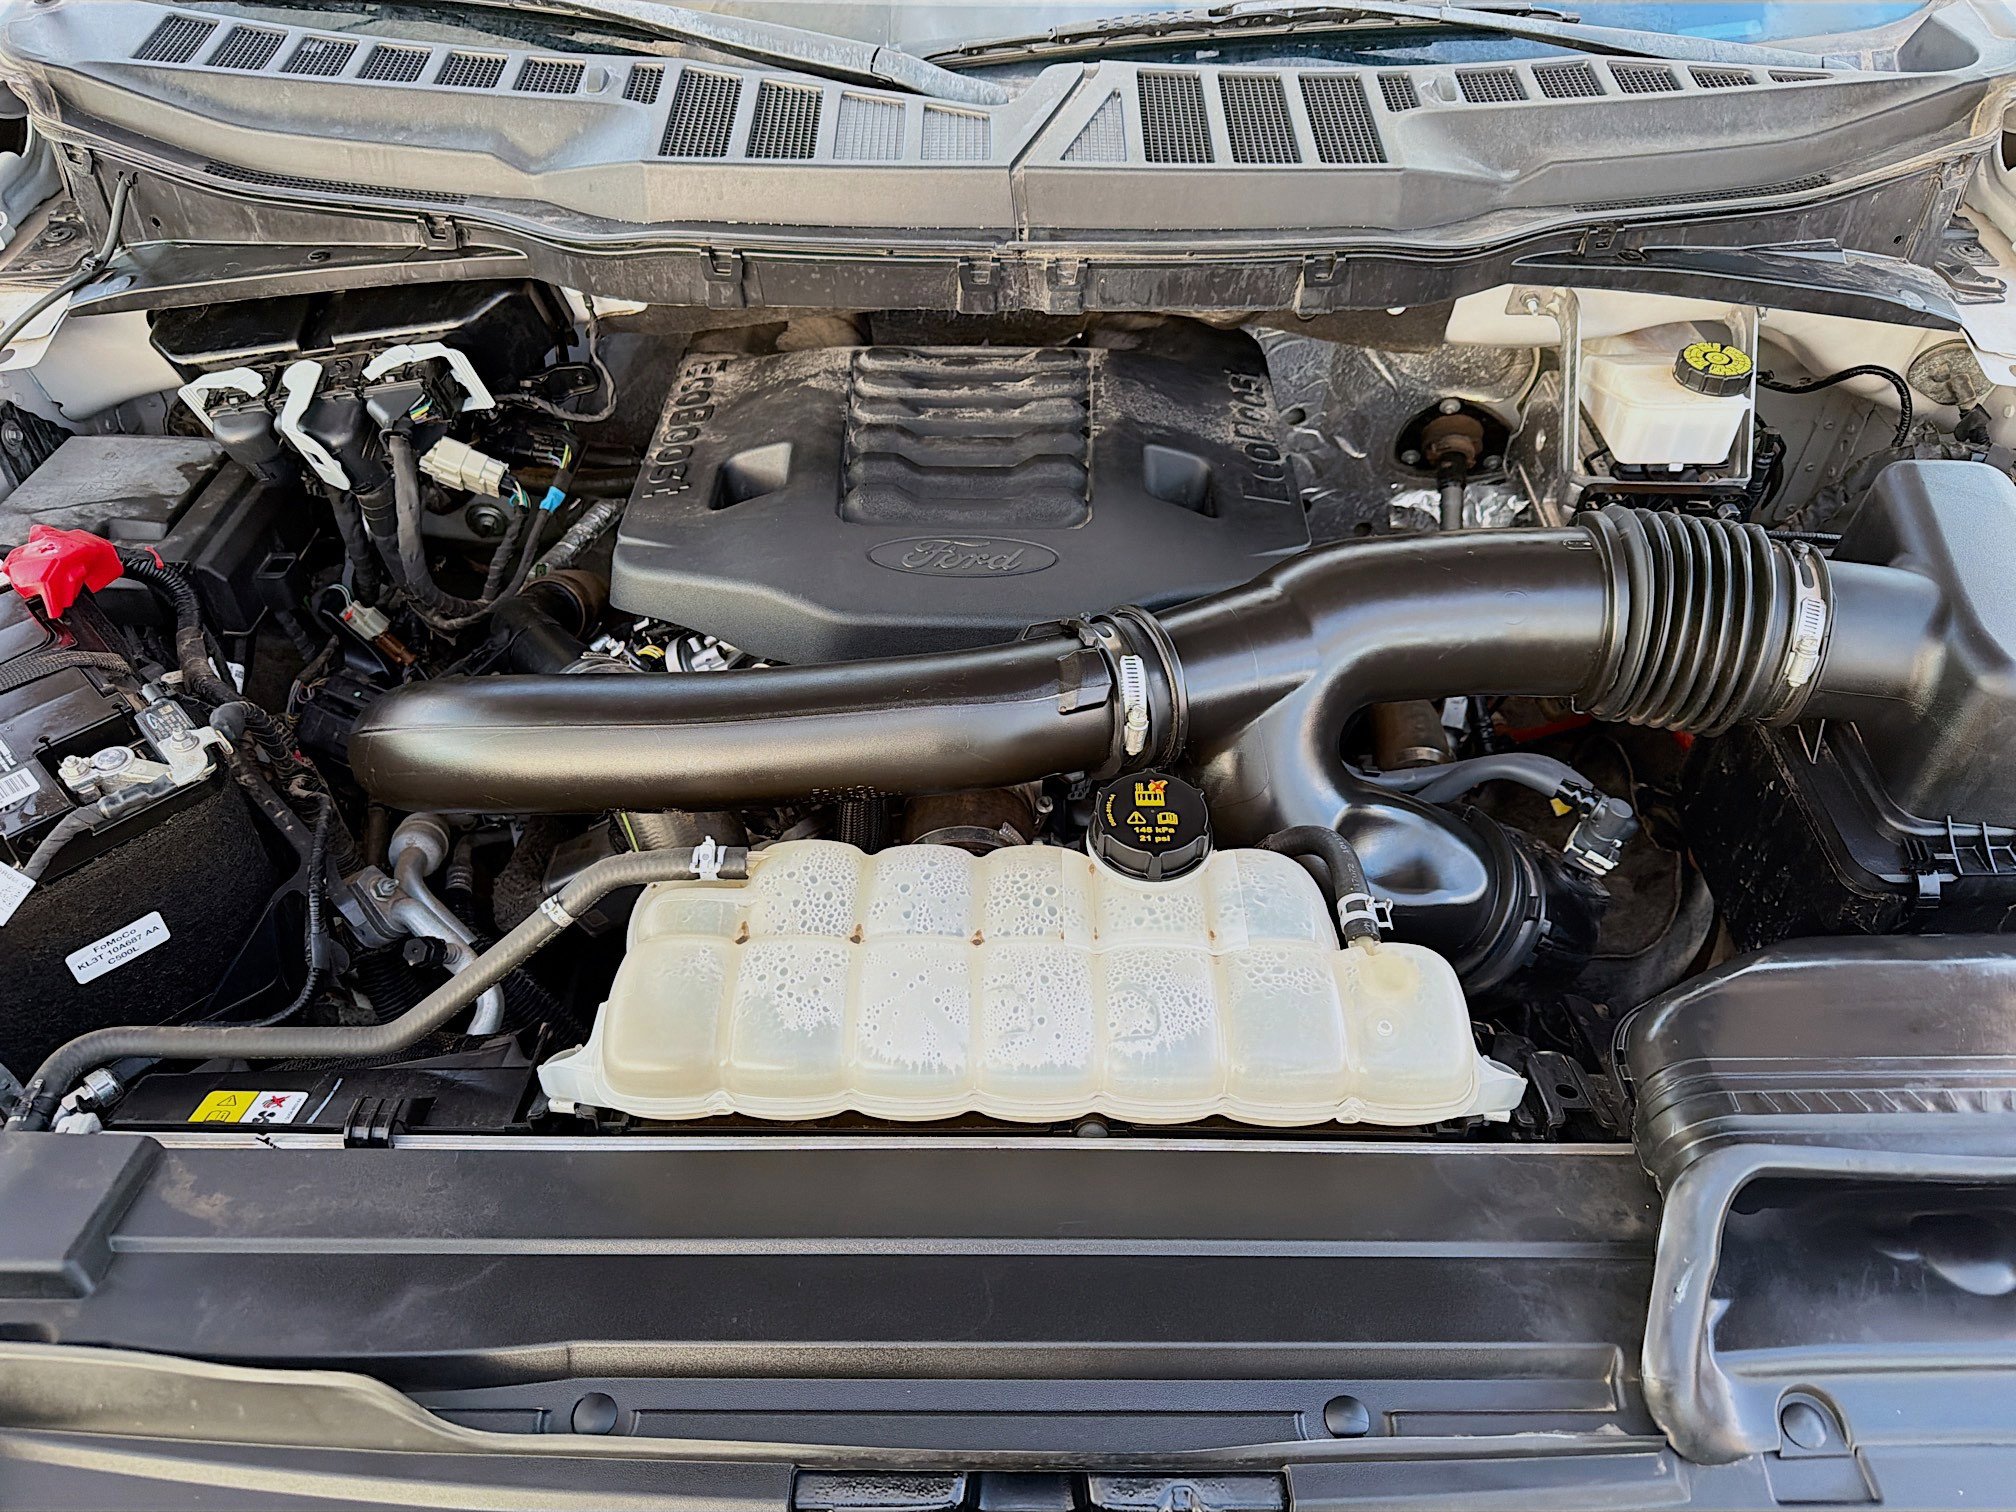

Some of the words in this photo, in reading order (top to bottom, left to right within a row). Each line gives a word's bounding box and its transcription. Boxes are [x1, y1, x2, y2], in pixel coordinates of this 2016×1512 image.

[901, 538, 1026, 572] Ford
[1133, 826, 1153, 834] 145
[1155, 826, 1175, 834] kPa
[1139, 834, 1152, 842] 21
[1154, 834, 1171, 843] psi
[77, 953, 104, 971] KL3T
[107, 933, 142, 955] 10A687
[145, 925, 160, 936] AA
[93, 928, 137, 953] FoMoCo
